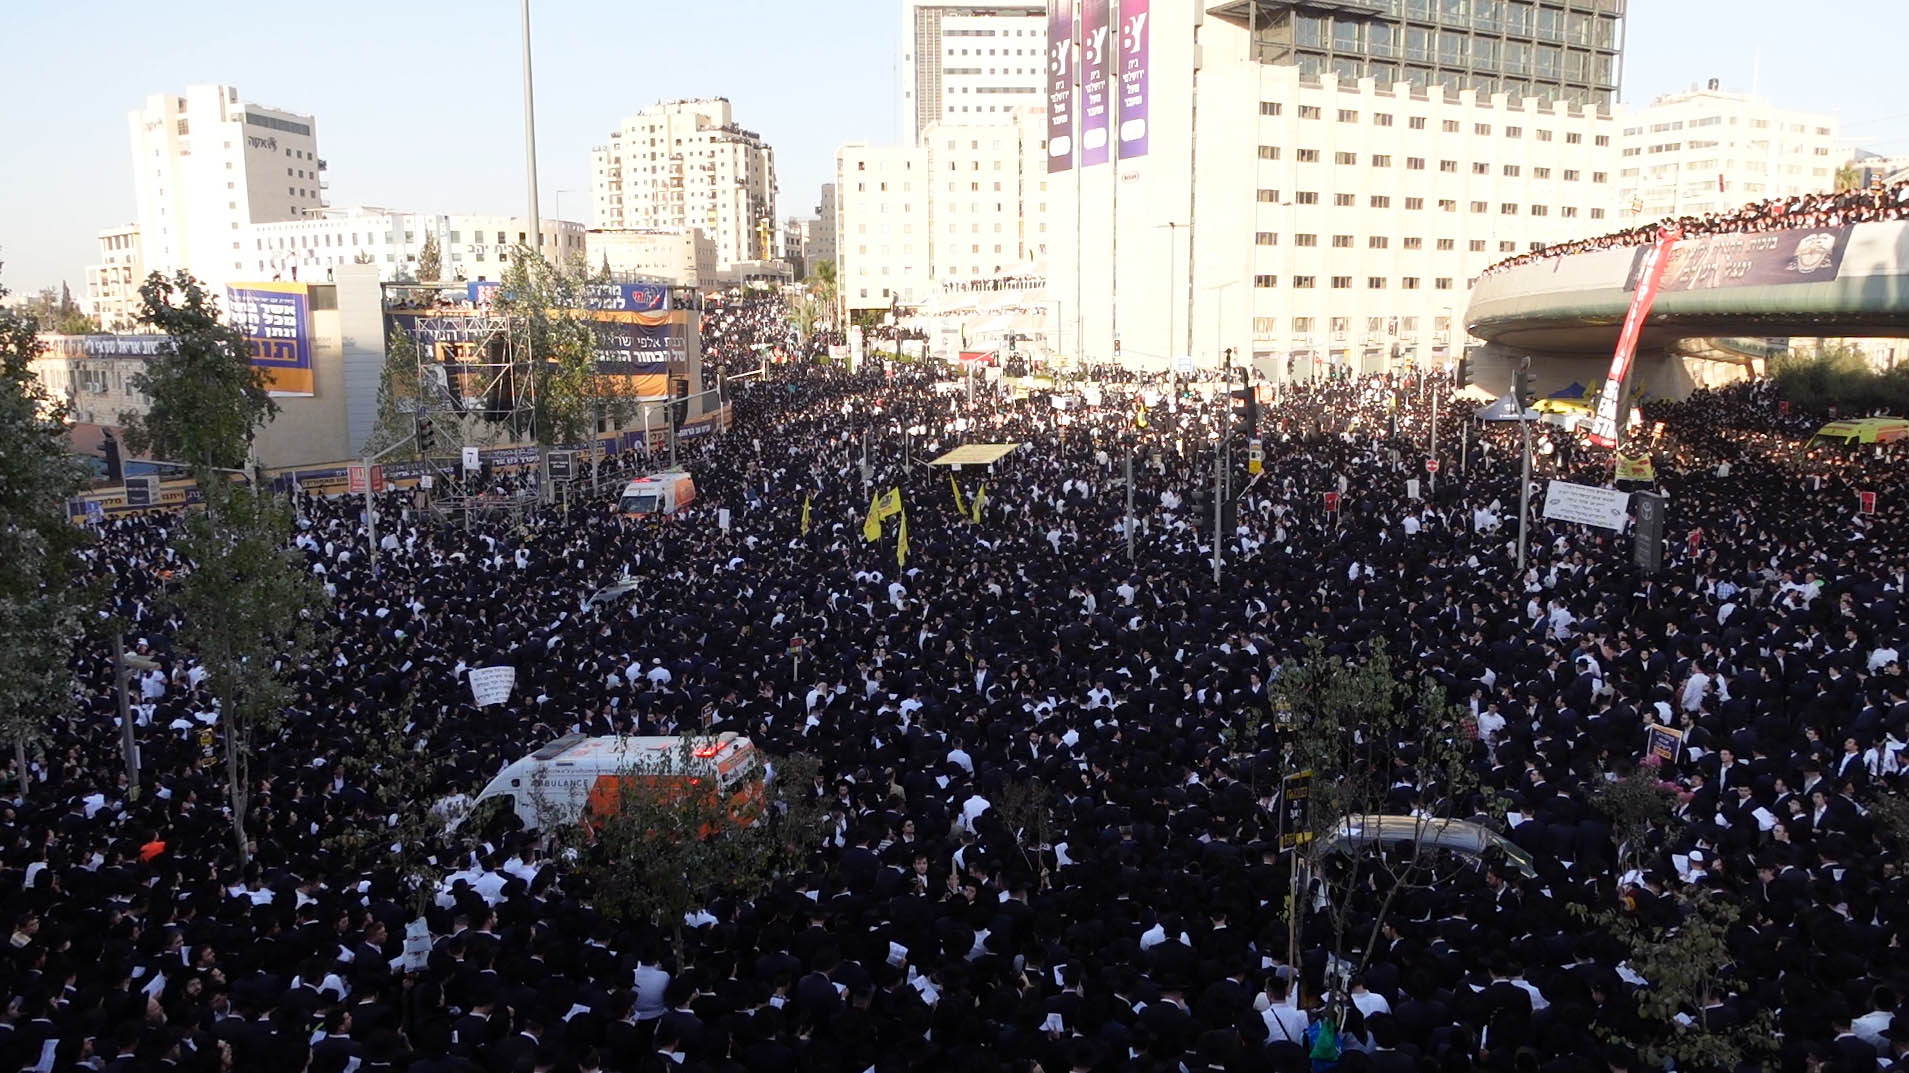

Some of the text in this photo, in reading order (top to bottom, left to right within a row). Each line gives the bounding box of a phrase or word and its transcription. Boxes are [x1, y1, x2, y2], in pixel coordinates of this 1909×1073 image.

[1124, 12, 1147, 54] BY
[1086, 25, 1108, 65] BY
[1051, 38, 1071, 76] BY
[1127, 58, 1139, 70] בית
[260, 303, 297, 316] אשר
[262, 313, 296, 327] מכל
[637, 334, 661, 348] אלפי
[466, 452, 475, 464] 7
